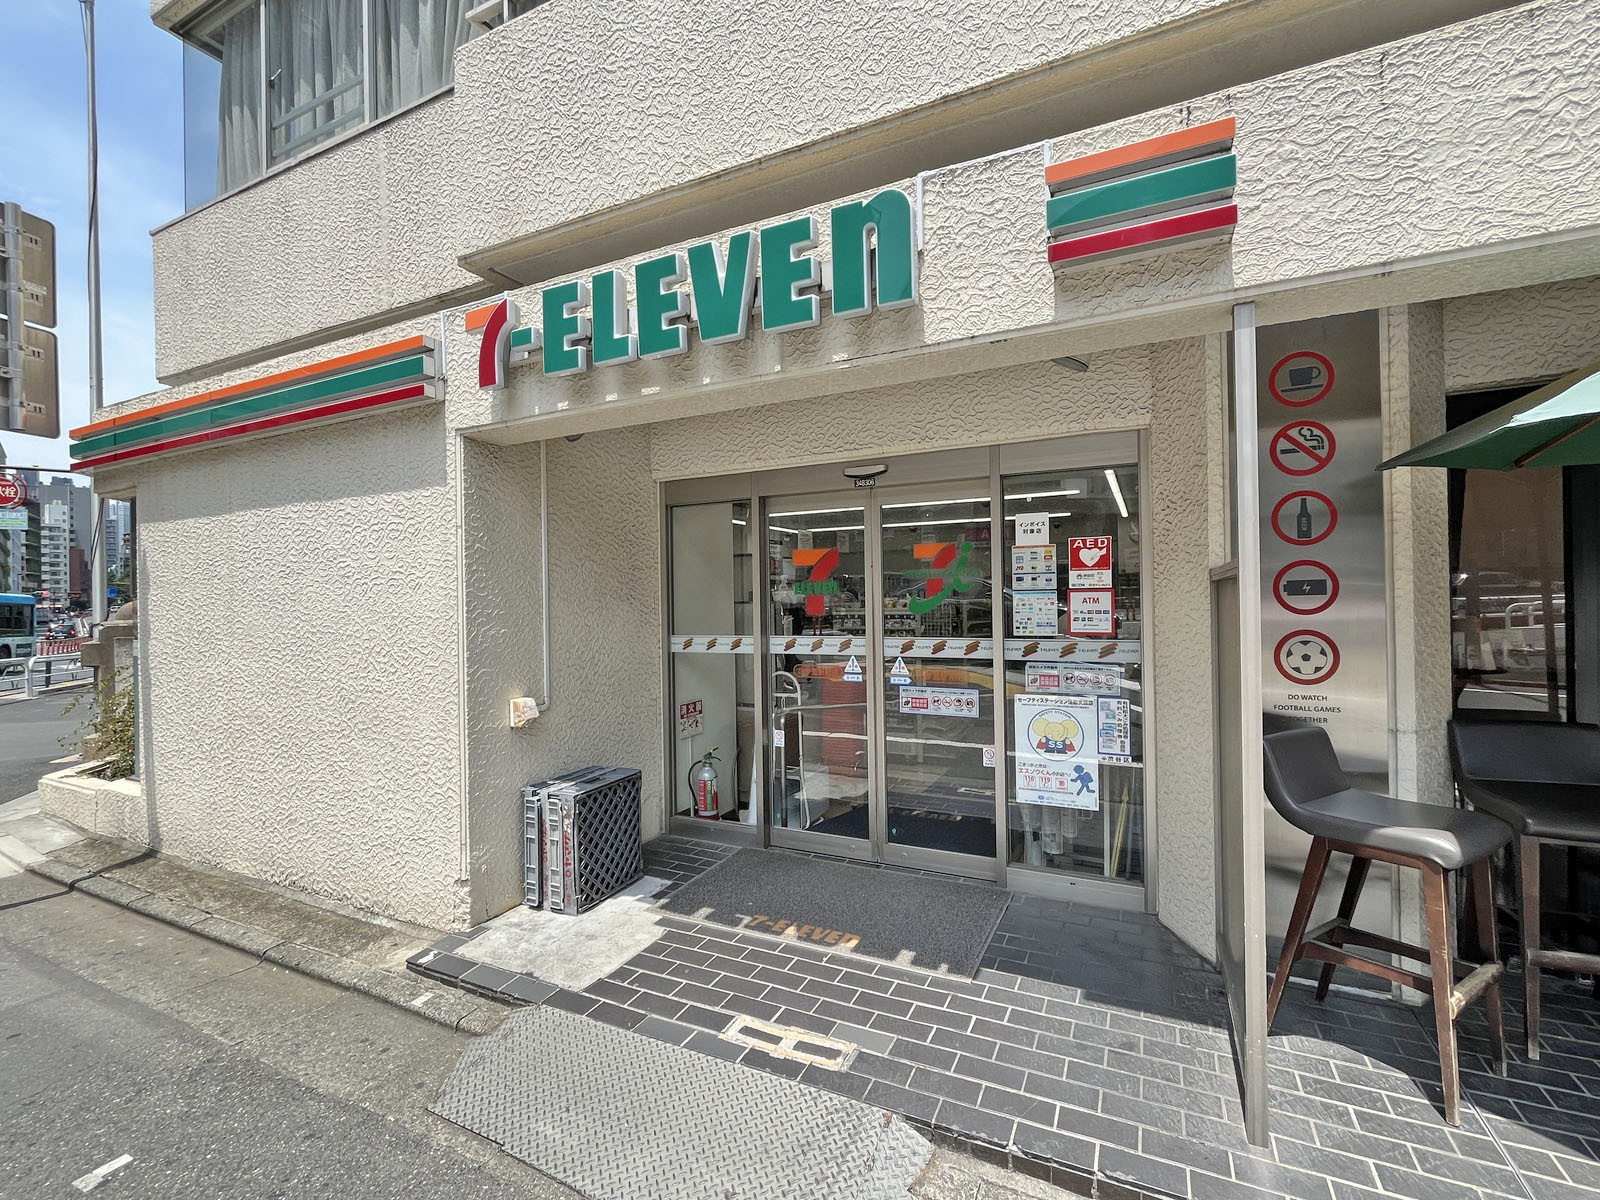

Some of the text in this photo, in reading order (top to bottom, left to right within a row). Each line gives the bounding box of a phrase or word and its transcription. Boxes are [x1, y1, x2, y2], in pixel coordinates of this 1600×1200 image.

[1072, 538, 1108, 549] AED
[1273, 704, 1312, 712] FOOTBALL
[1047, 740, 1064, 749] SS
